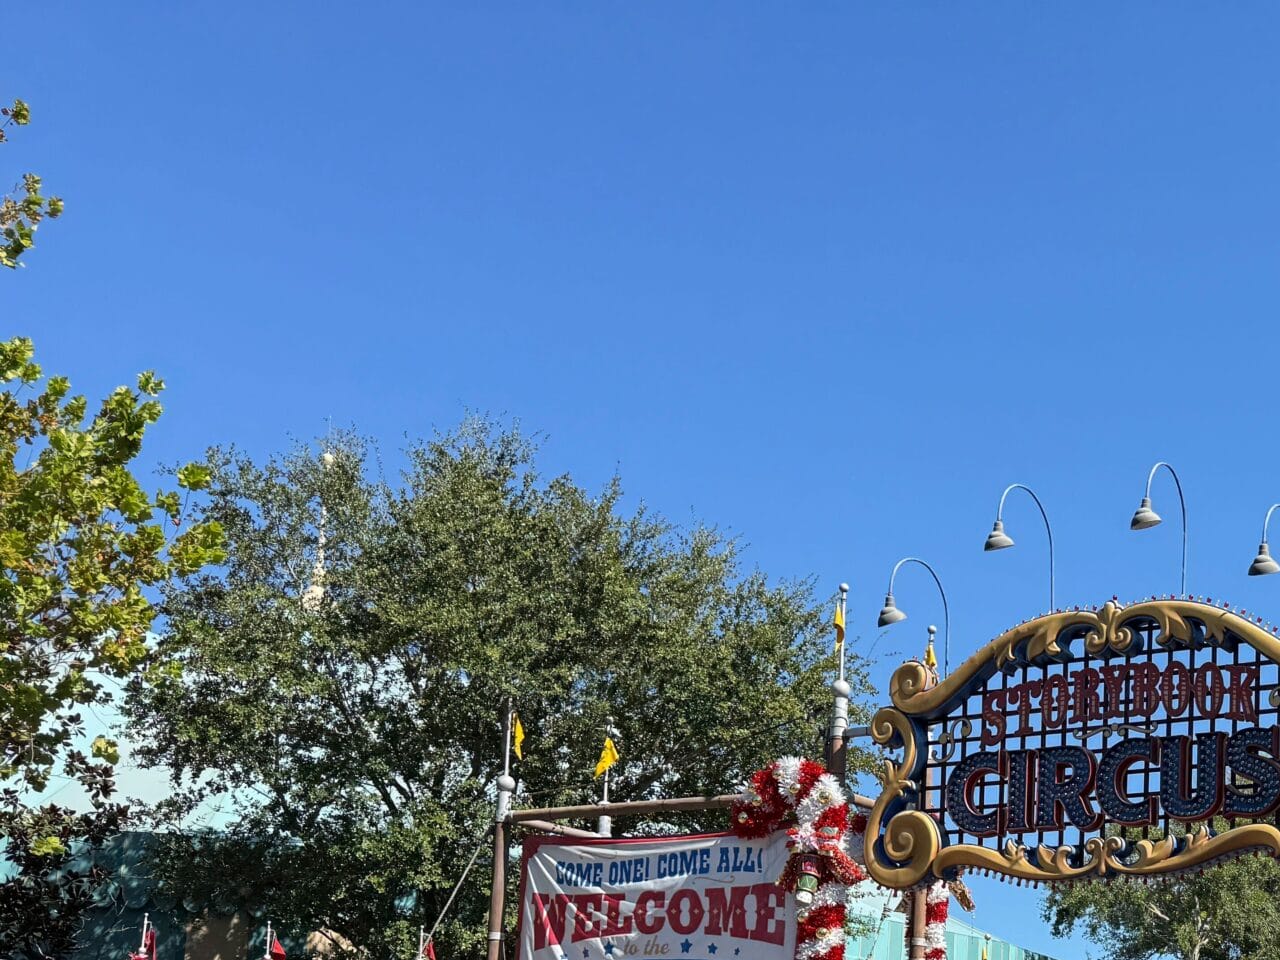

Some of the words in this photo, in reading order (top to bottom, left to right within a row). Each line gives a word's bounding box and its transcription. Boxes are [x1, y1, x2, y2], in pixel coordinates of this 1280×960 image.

[981, 660, 1258, 750] STORYBOOK
[556, 861, 603, 887] COME
[609, 857, 649, 884] ONE!
[657, 851, 710, 878] COME
[717, 847, 763, 873] ALL!
[532, 884, 785, 951] WELCOME
[624, 942, 638, 955] to
[644, 935, 670, 955] the
